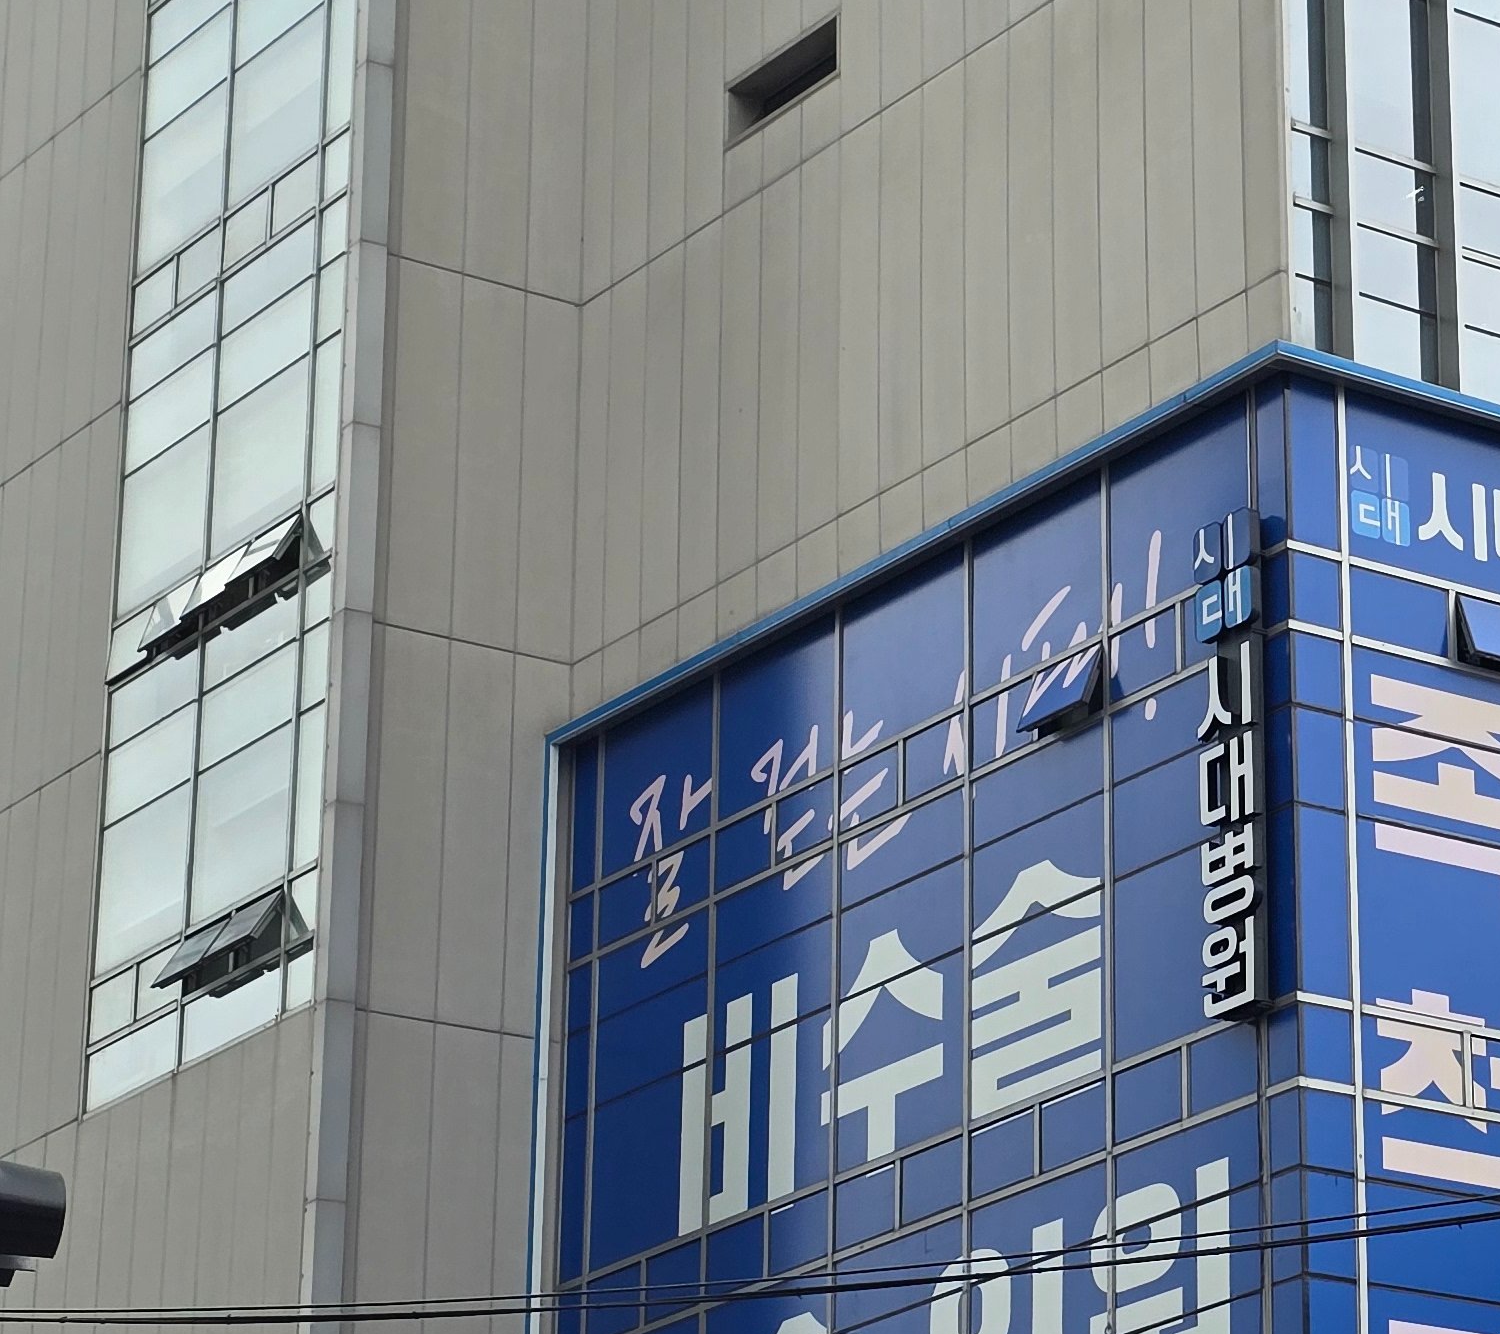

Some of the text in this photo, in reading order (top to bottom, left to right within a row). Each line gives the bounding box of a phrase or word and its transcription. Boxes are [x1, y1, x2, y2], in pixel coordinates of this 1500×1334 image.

[1195, 514, 1241, 634] 시대
[1350, 445, 1410, 547] 시대
[629, 775, 711, 969] 잘
[1197, 644, 1256, 1019] 시대병원
[678, 858, 1102, 1237] 비수술
